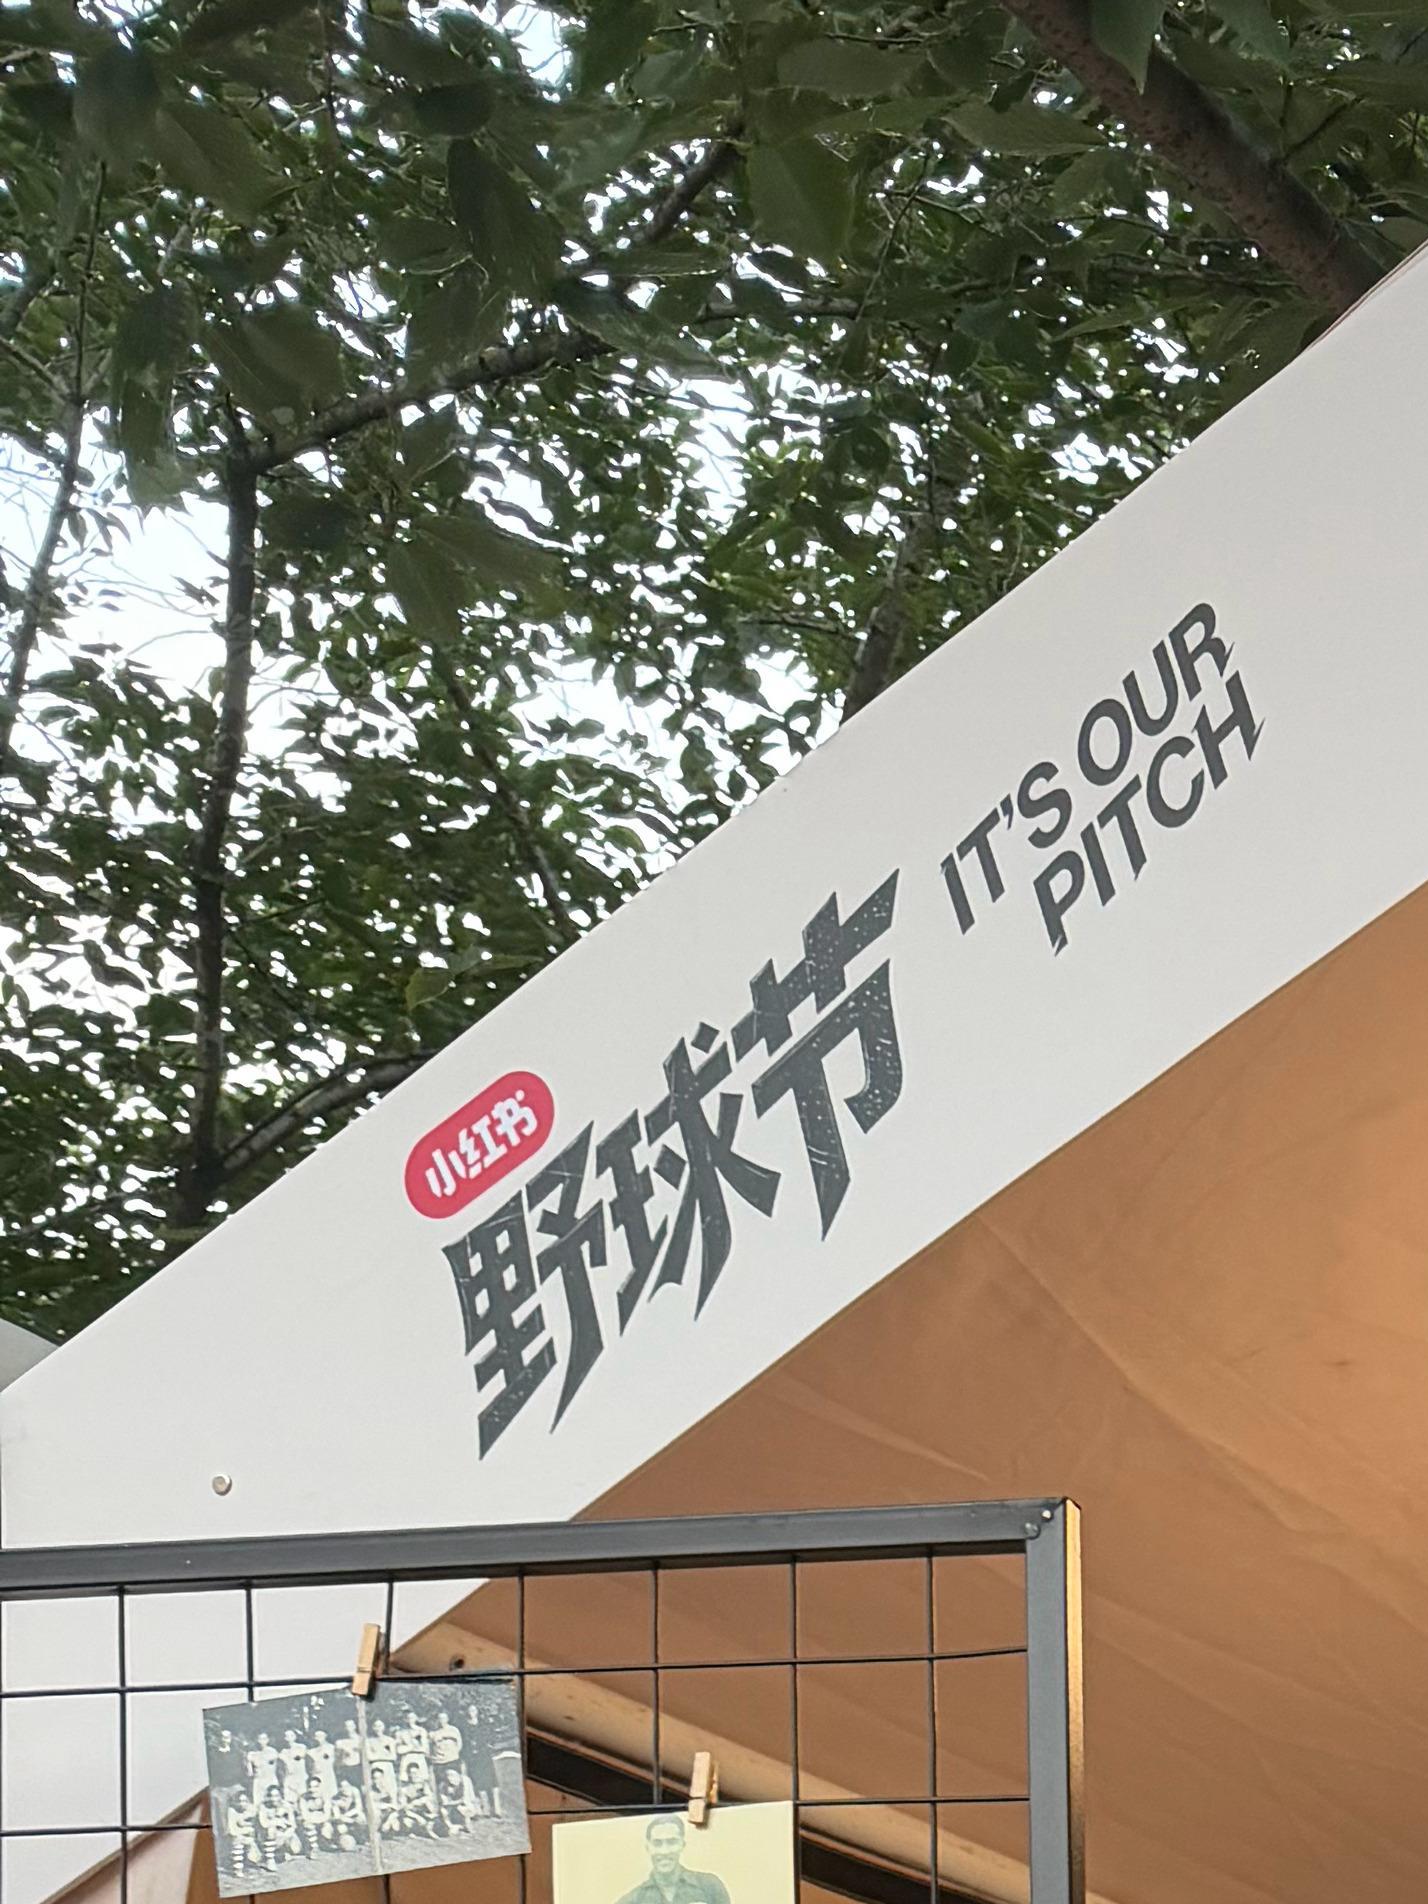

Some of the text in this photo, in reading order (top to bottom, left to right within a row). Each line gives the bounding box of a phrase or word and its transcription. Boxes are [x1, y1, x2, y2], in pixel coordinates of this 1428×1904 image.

[937, 601, 1237, 936] IT'S OUR
[1029, 667, 1266, 957] PITCH
[424, 1089, 538, 1199] 小红书
[441, 868, 904, 1461] 野球节
